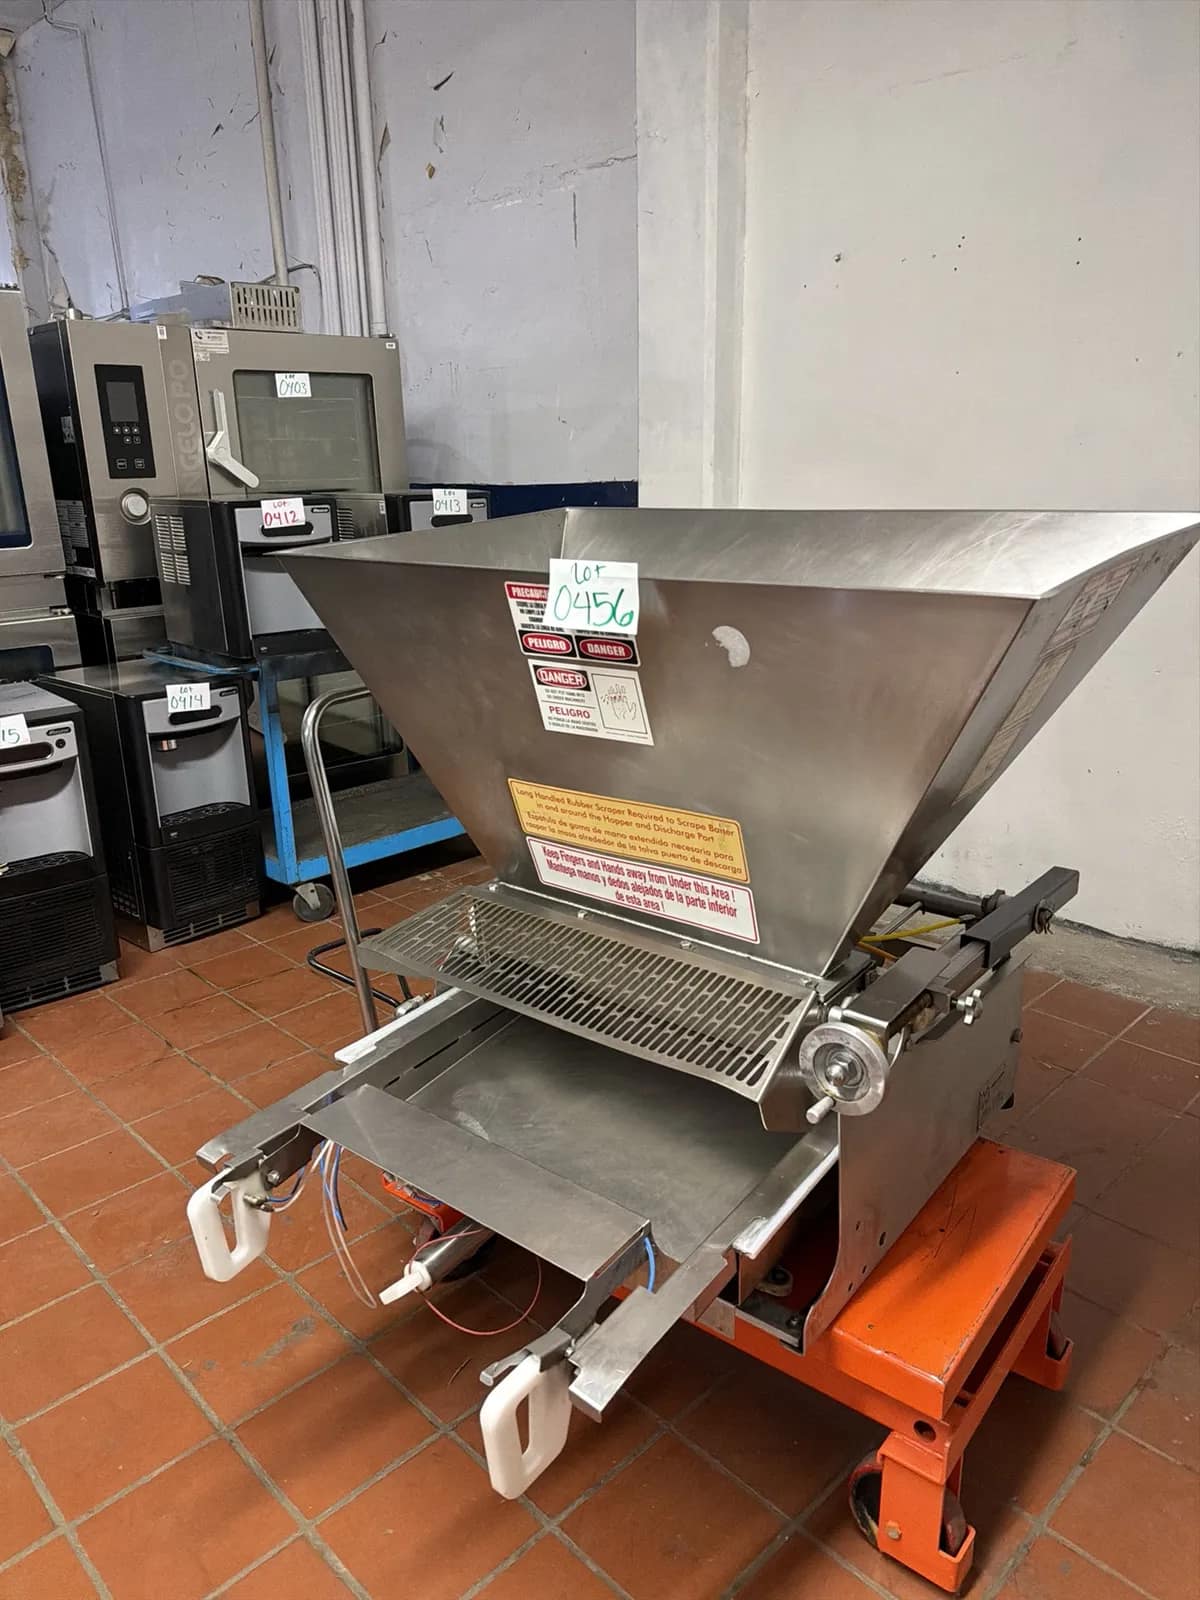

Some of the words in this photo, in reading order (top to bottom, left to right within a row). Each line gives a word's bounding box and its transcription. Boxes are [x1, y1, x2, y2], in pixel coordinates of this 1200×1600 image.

[434, 499, 461, 512] 0413
[264, 510, 300, 527] 0412
[554, 585, 634, 627] 0456
[527, 637, 567, 650] PELIGRO
[586, 643, 626, 657] DANGER
[540, 670, 584, 686] DANGER
[171, 695, 203, 709] 0414
[549, 705, 591, 719] PELIGRO
[2, 729, 20, 744] 15
[516, 787, 534, 799] Long
[535, 791, 566, 804] Handled
[567, 798, 593, 809] Rubber
[595, 803, 625, 815] Scraper
[627, 809, 664, 822] Required
[676, 817, 706, 830] Scrape
[545, 804, 559, 813] and
[603, 815, 633, 827] Hopper
[635, 822, 651, 831] and
[654, 824, 695, 839] Discharge
[697, 832, 714, 842] Port
[587, 859, 601, 870] and
[601, 860, 625, 876] Hands
[626, 868, 647, 883] away
[648, 870, 667, 885] from
[668, 875, 691, 891] Under
[693, 881, 709, 896] this
[615, 890, 625, 901] de
[631, 881, 663, 898] alejados
[665, 888, 675, 901] de
[675, 890, 684, 904] la
[685, 895, 706, 909] parte
[707, 898, 737, 918] inferior
